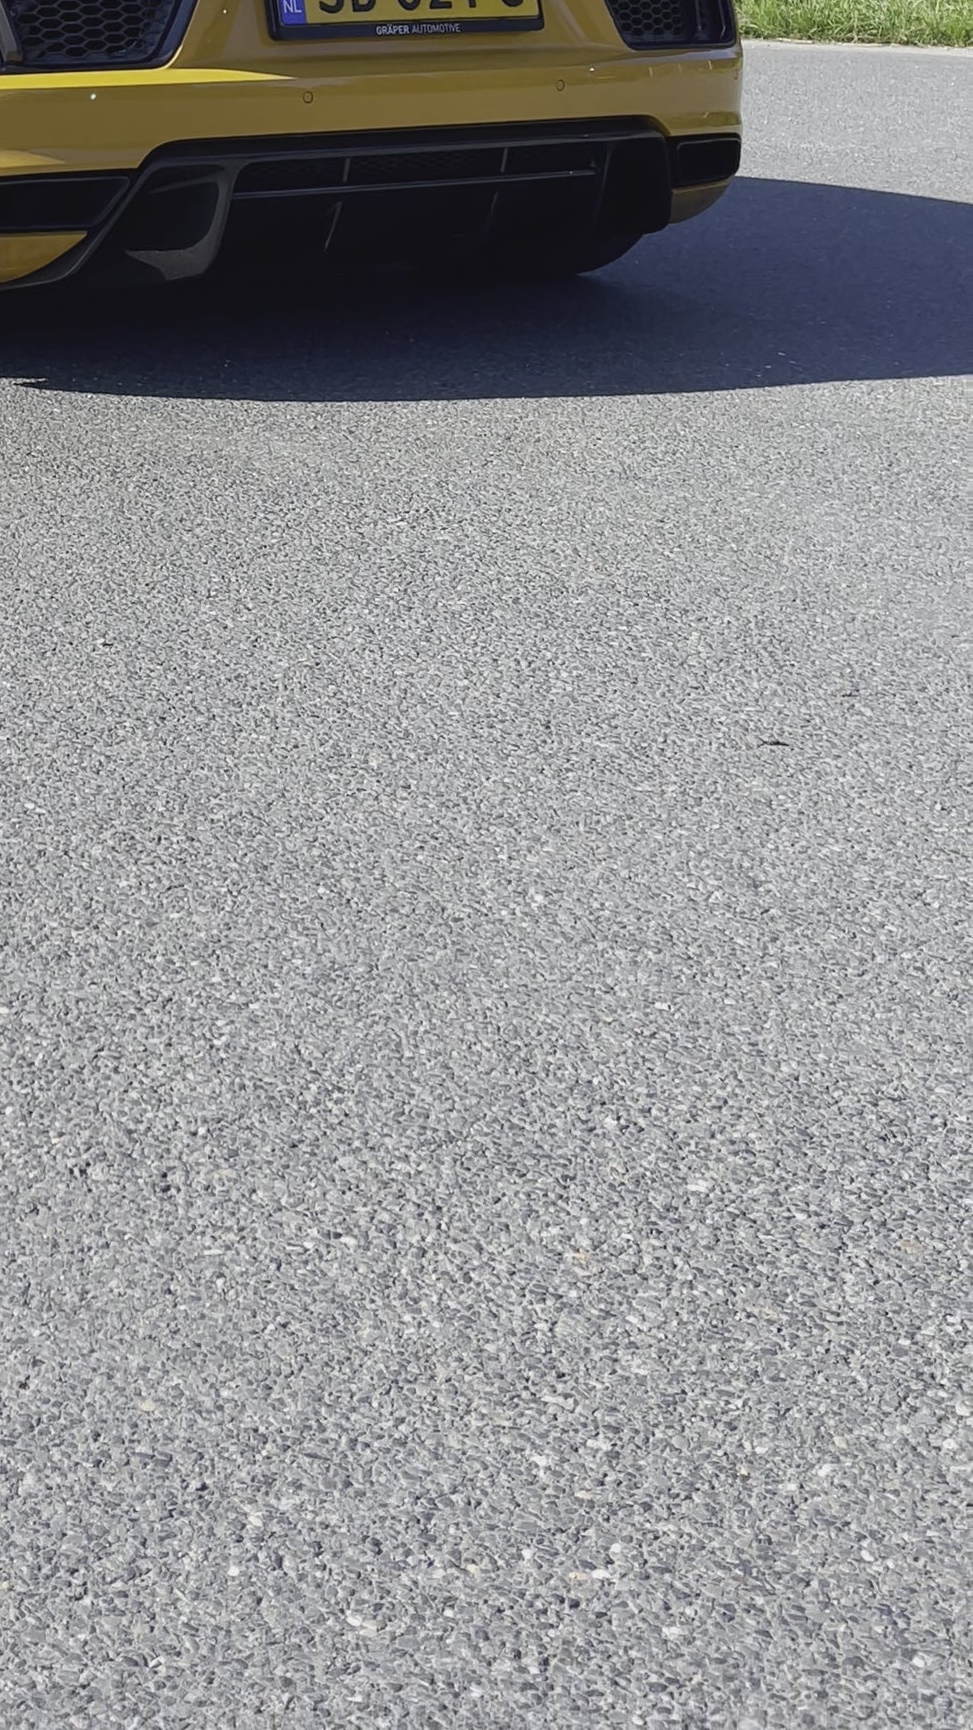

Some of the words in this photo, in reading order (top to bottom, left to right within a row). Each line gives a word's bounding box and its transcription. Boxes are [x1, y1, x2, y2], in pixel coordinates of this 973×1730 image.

[283, 0, 302, 14] NL
[376, 23, 410, 36] GRÄPER
[411, 23, 461, 34] AUTOMOTIVE
